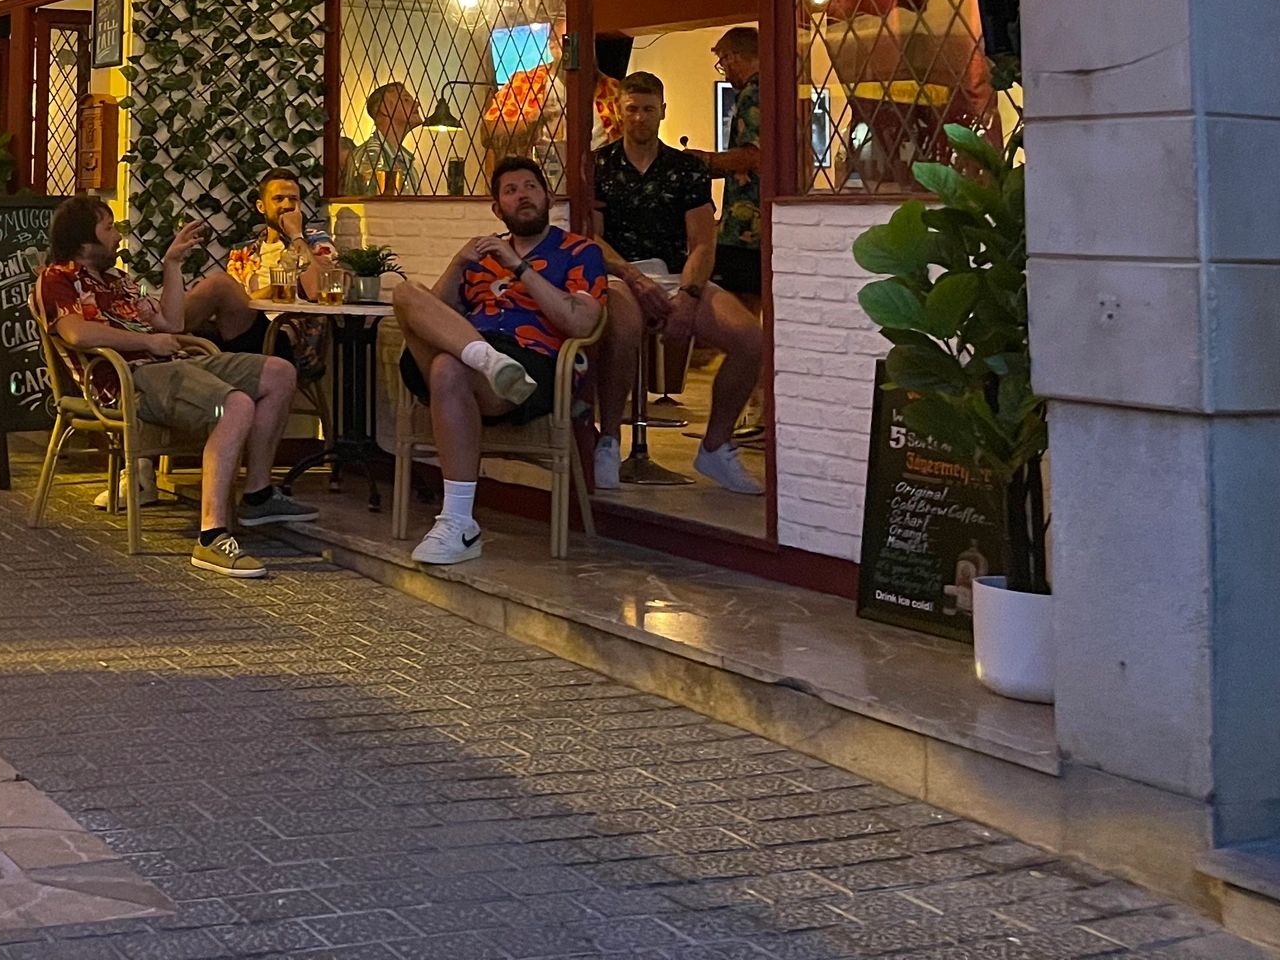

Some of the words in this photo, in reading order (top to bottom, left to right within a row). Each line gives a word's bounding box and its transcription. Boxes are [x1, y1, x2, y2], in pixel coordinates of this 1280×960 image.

[1, 282, 29, 310] EST
[1, 319, 40, 348] CAR
[10, 367, 51, 396] CAR
[889, 426, 907, 449] 5
[895, 481, 949, 501] Original
[890, 497, 917, 512] Cold
[948, 504, 987, 524] Coffee
[875, 589, 898, 604] Drink
[898, 596, 910, 607] ice
